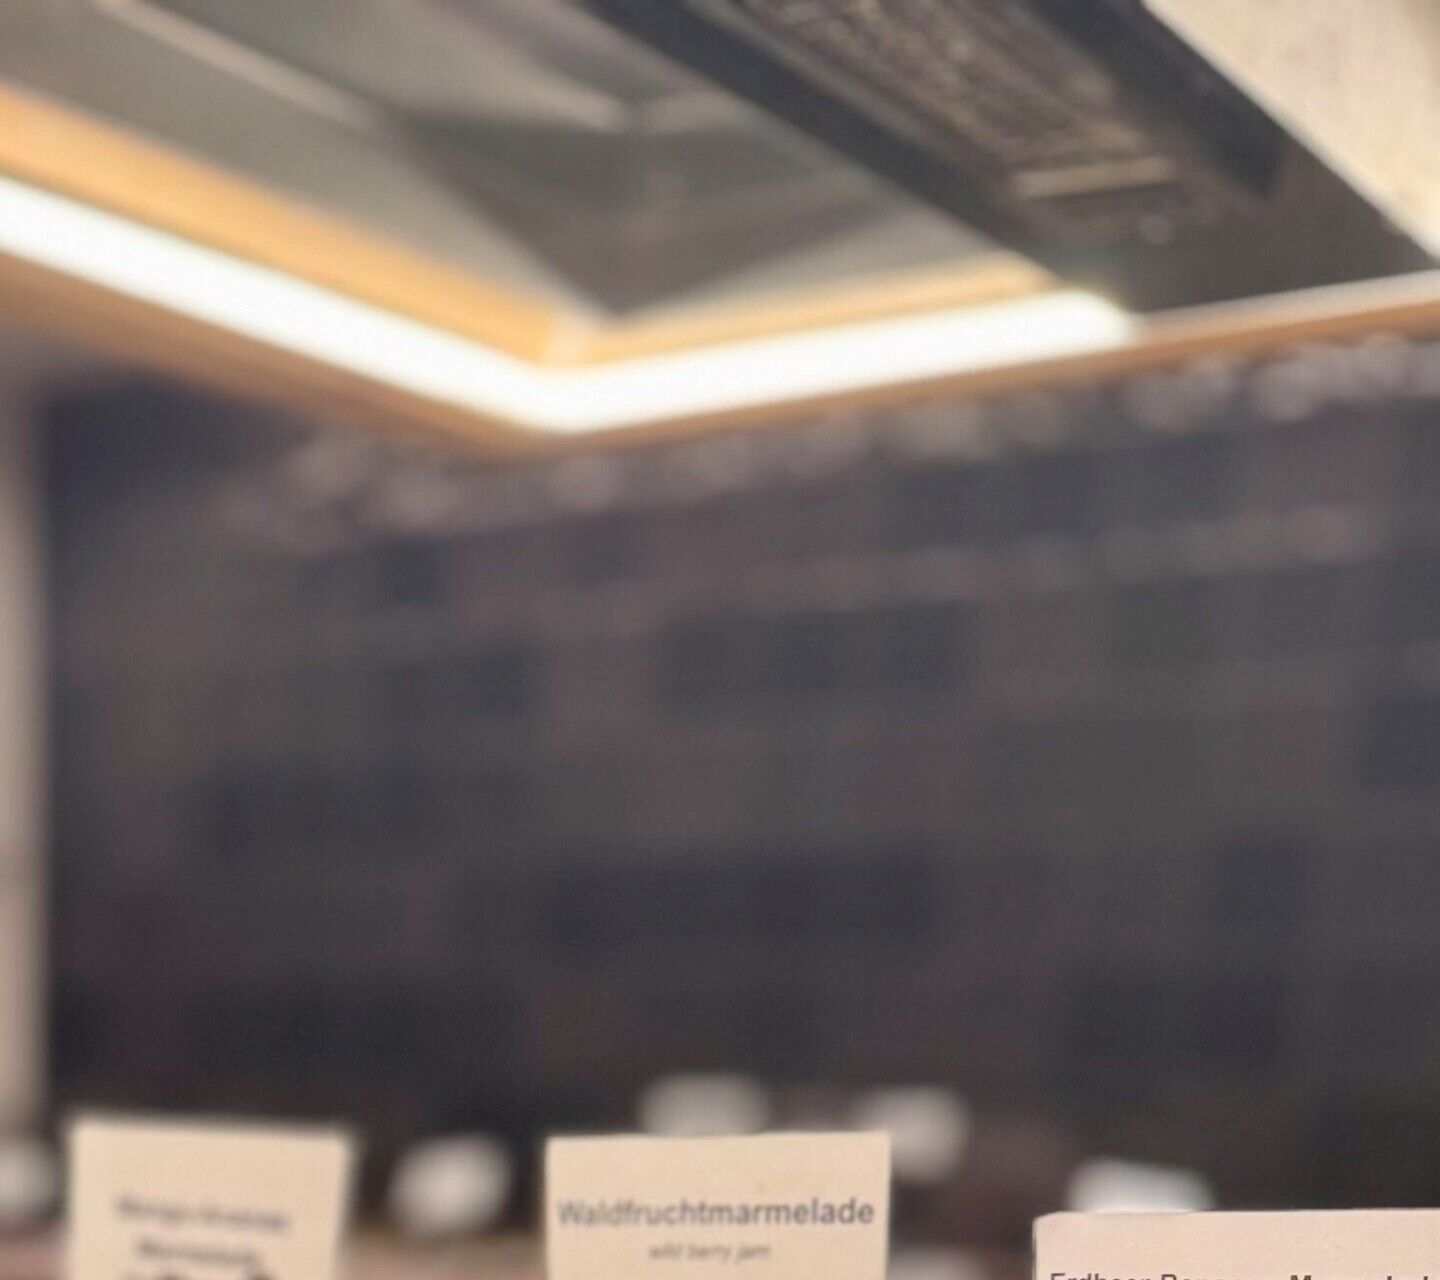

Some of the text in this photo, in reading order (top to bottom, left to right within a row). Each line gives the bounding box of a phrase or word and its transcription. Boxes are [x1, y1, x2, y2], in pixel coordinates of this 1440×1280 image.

[560, 1198, 875, 1225] Waldfruchtmarmelade
[687, 1243, 732, 1265] berry
[734, 1243, 772, 1265] jam
